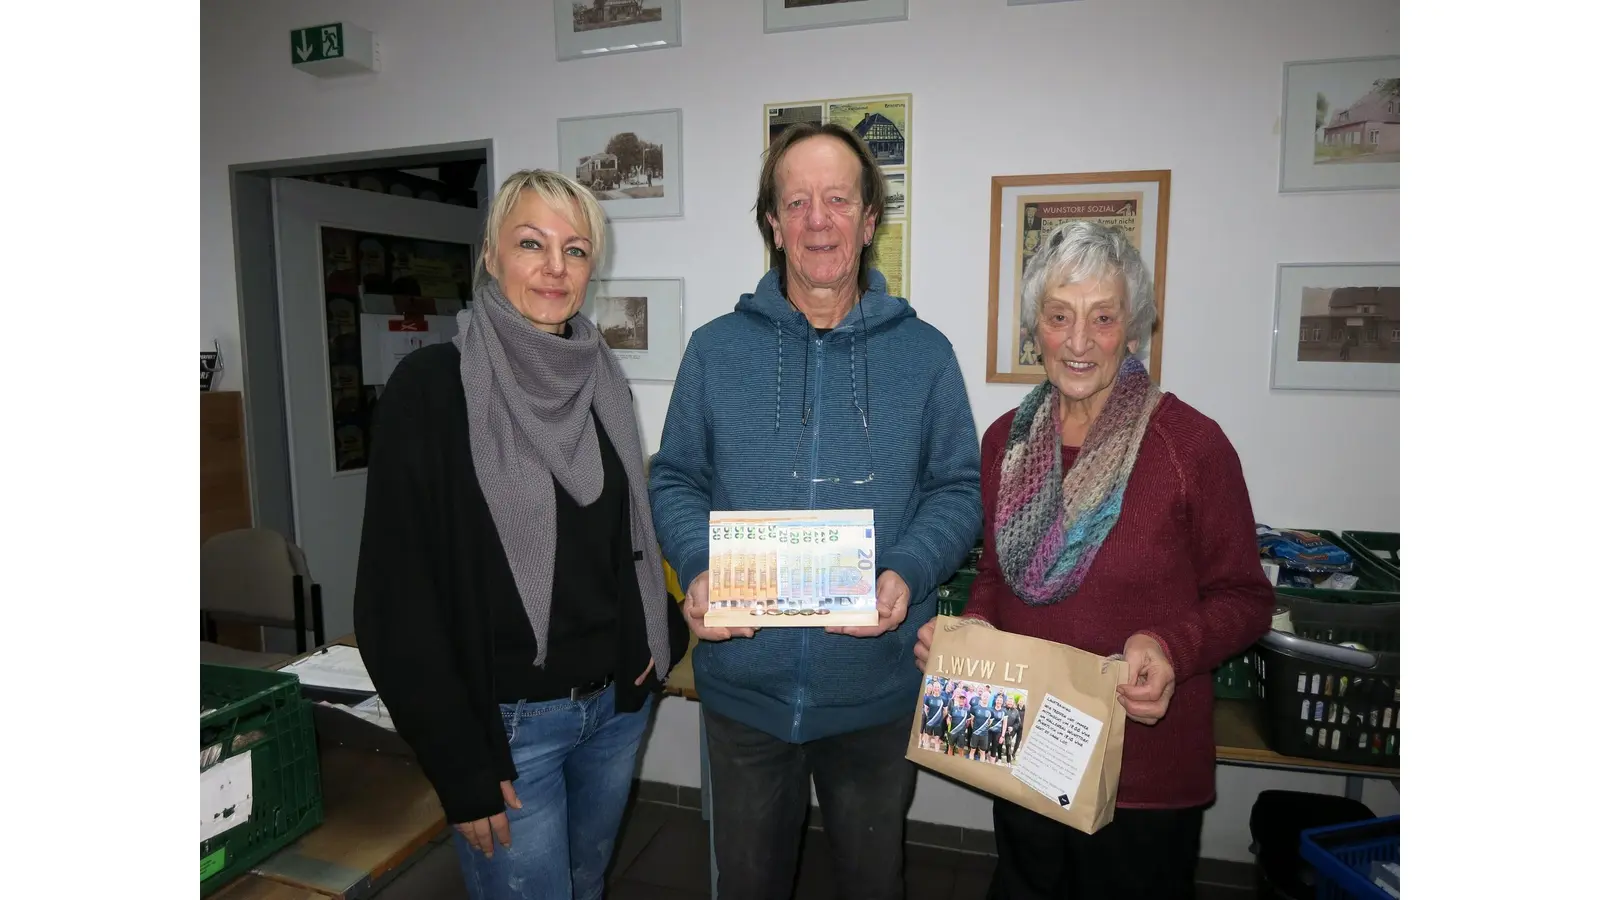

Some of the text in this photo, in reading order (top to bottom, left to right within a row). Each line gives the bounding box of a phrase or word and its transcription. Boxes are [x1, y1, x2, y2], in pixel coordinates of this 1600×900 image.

[1042, 204, 1116, 214] WUNSTORF SOZIAL
[712, 527, 721, 541] 50
[779, 530, 788, 543] 20
[789, 532, 800, 545] 20
[802, 530, 812, 543] 20
[828, 529, 839, 542] 20
[857, 548, 873, 571] 20
[1004, 661, 1029, 684] LT
